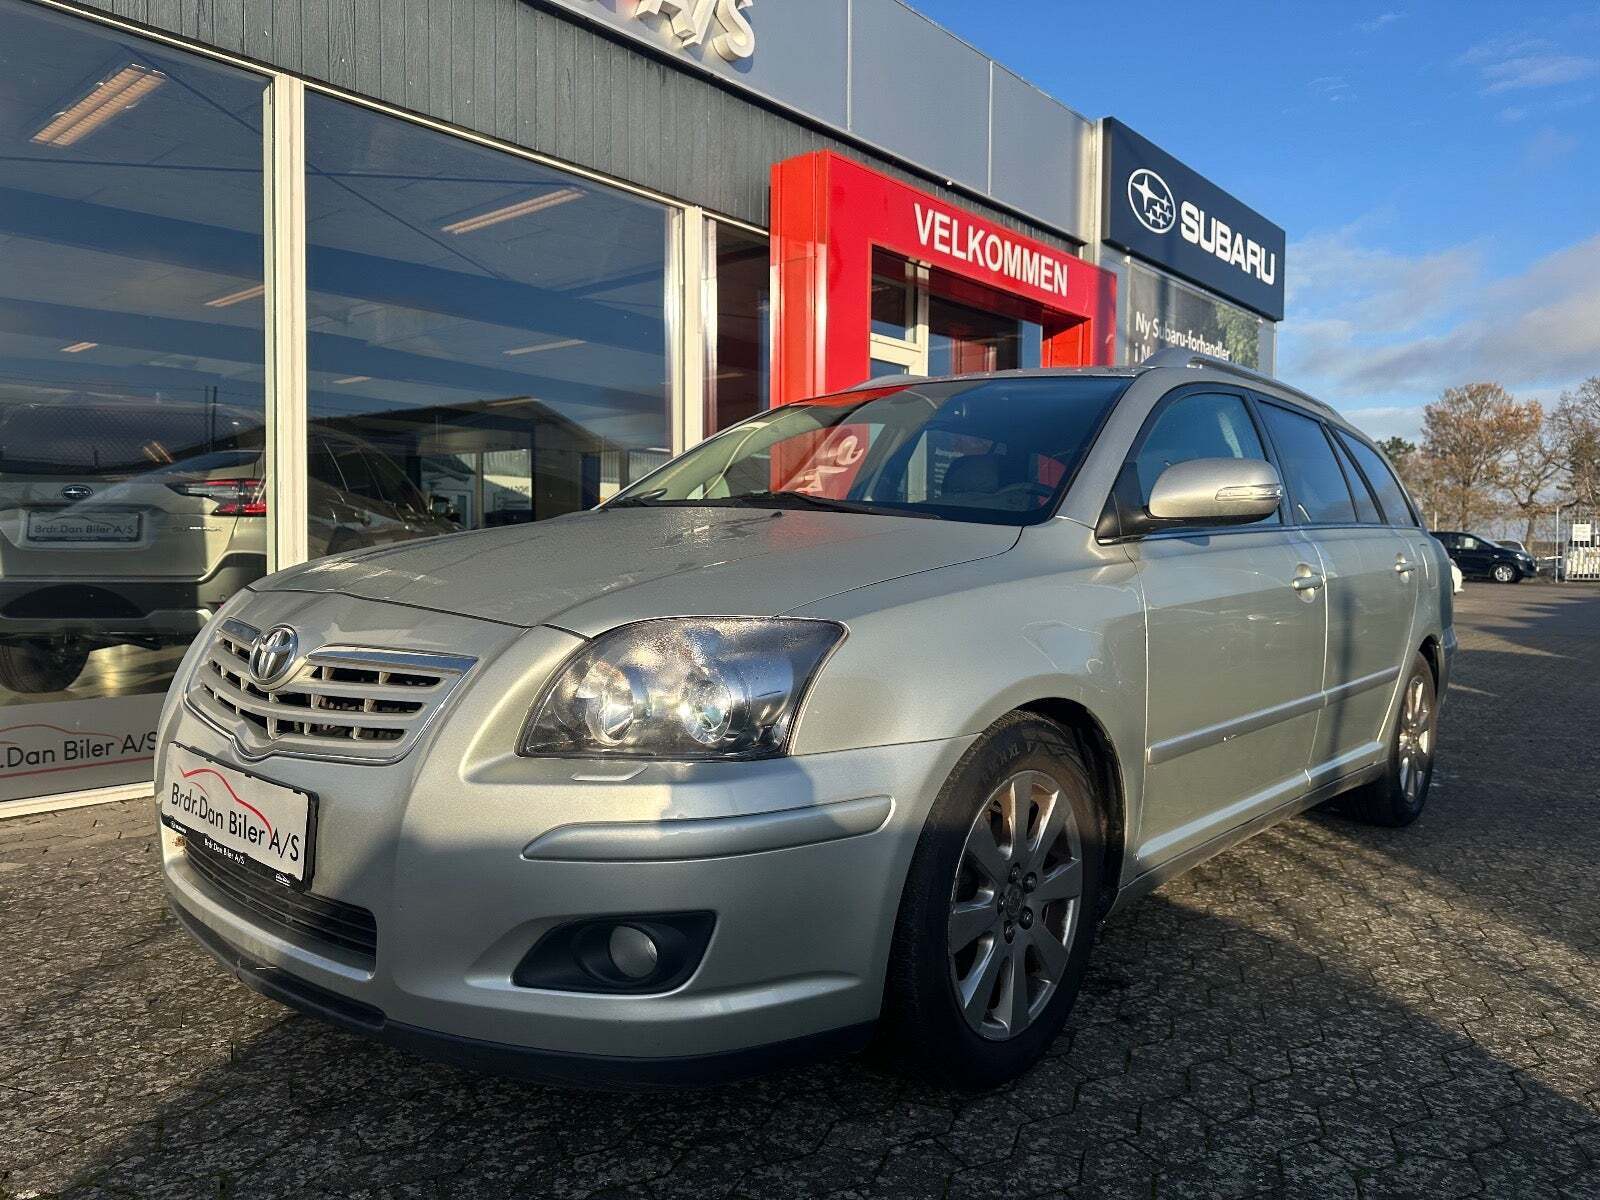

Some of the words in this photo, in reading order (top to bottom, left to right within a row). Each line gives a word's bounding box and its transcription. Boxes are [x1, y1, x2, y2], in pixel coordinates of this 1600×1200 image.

[914, 203, 1069, 297] VELKOMMEN
[1180, 201, 1276, 285] SUBARU
[1136, 311, 1151, 340] Ny
[1152, 318, 1230, 361] Subaru-forhandler
[64, 739, 114, 761] Biler
[121, 731, 157, 754] A/S
[171, 783, 224, 829] Brdr.Dan
[229, 811, 265, 845] Biler
[268, 827, 299, 862] A/S
